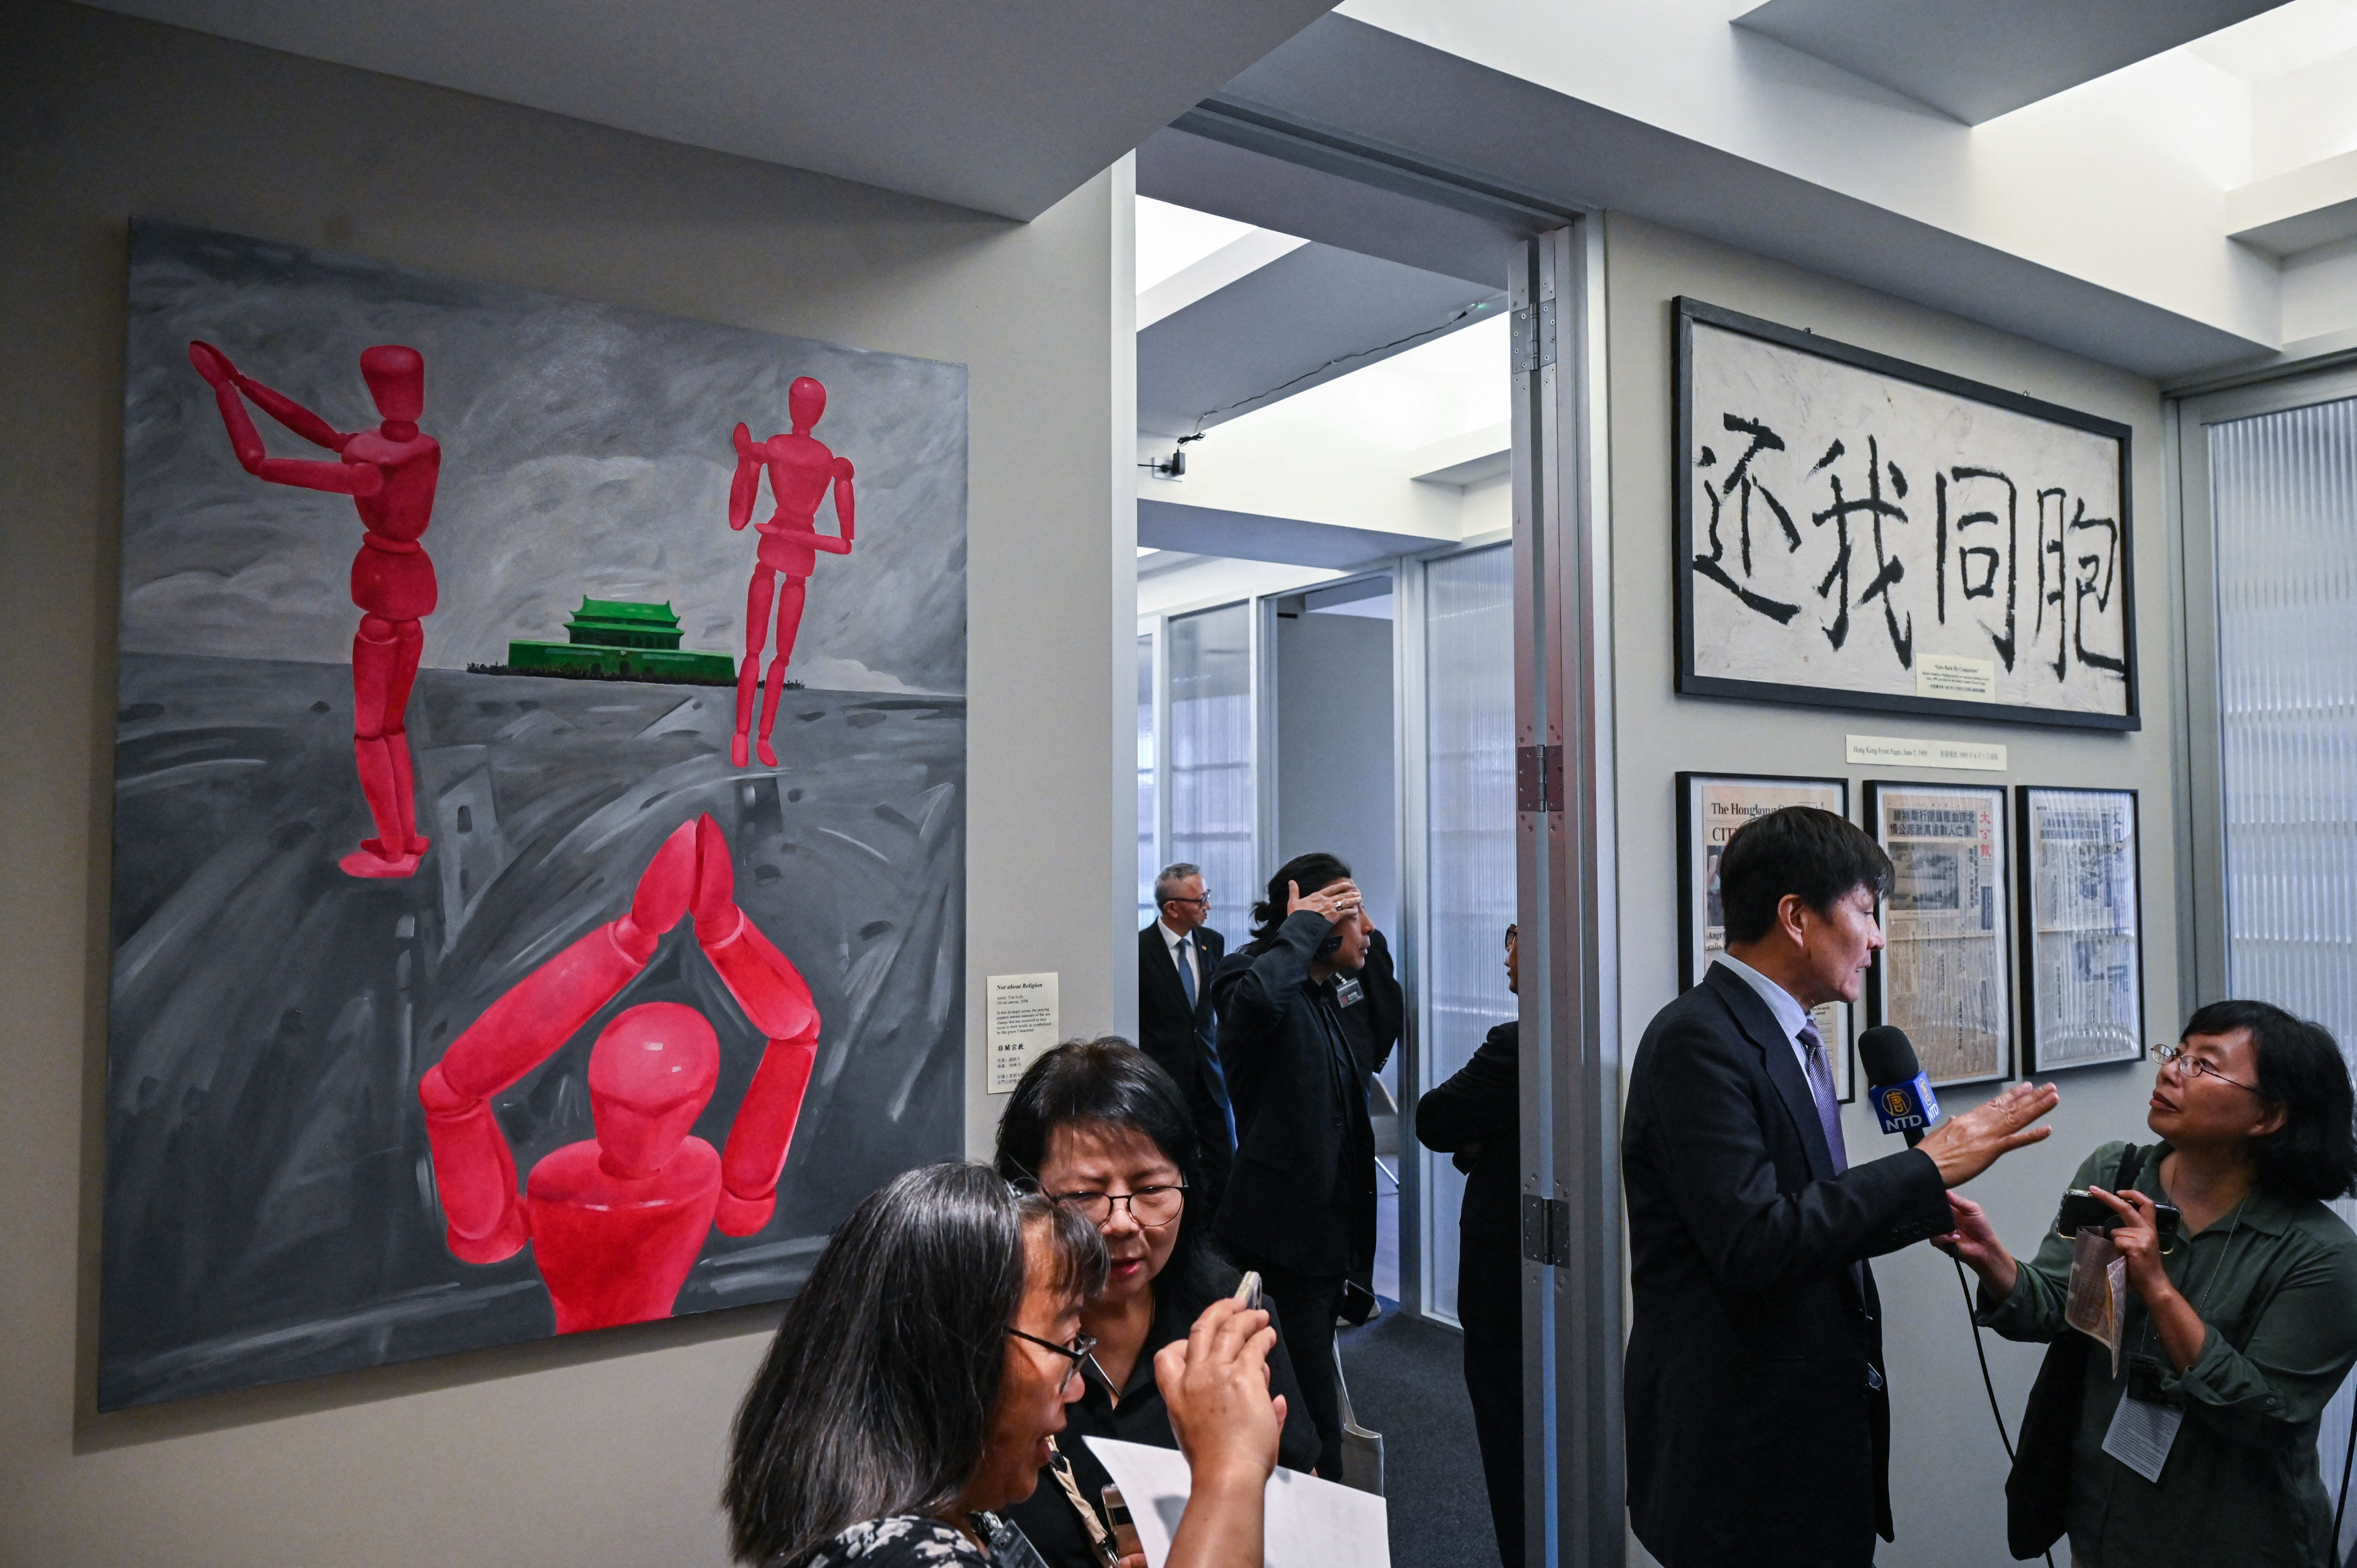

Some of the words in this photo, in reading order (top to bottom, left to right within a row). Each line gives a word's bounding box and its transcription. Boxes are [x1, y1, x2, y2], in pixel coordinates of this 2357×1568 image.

[1854, 746, 1865, 755] Hong
[1866, 747, 1877, 756] Kong
[1711, 802, 1729, 814] The
[1731, 803, 1777, 818] Hongkong
[1712, 827, 1737, 841] CIT
[1708, 942, 1722, 950] calls
[1927, 1103, 1939, 1122] NTD
[1885, 1115, 1923, 1132] NTD
